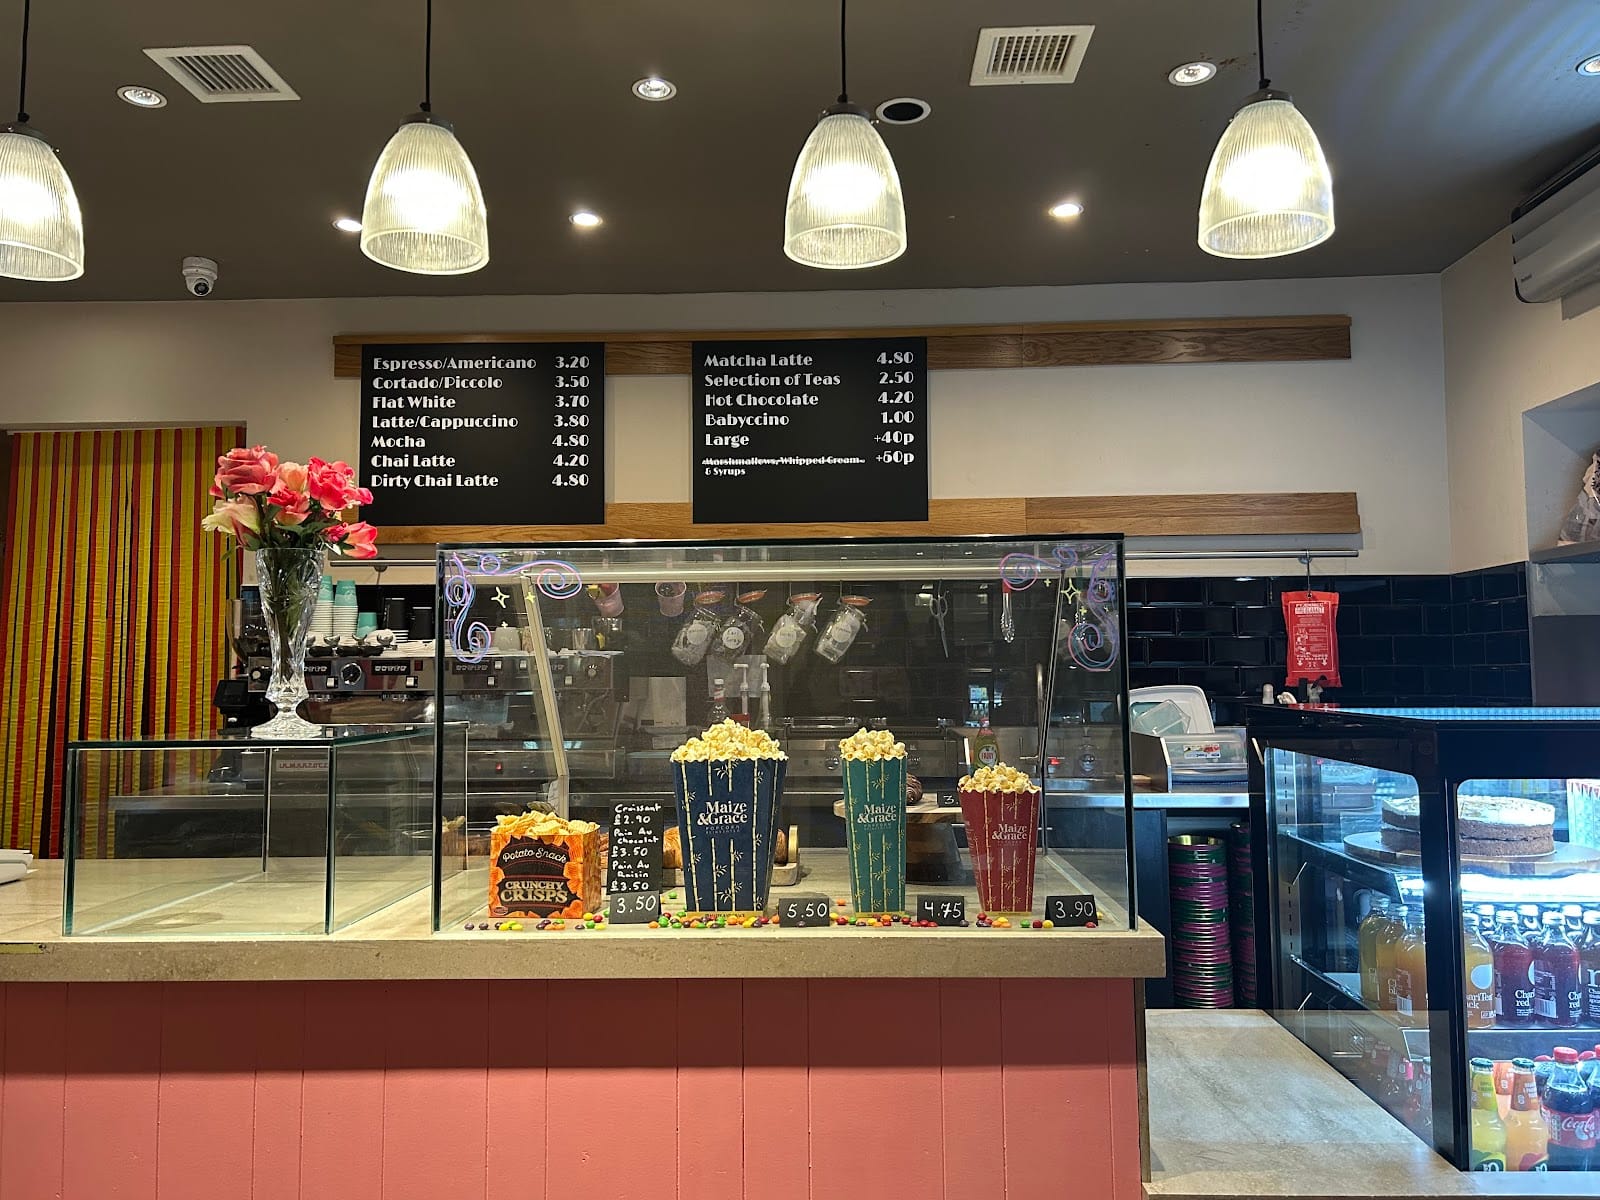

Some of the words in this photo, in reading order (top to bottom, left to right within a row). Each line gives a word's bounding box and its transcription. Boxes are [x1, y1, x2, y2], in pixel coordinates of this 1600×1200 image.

[374, 356, 536, 371] Espresso/Americano
[555, 355, 590, 369] 3.20
[705, 355, 766, 366] Matcha
[771, 354, 812, 366] Latte
[877, 352, 913, 364] 4.80
[373, 376, 502, 389] Cortado/Piccolo
[555, 376, 589, 387] 3.50
[705, 373, 780, 386] Selection
[784, 374, 801, 385] of
[803, 373, 840, 385] Teas
[880, 372, 913, 383] 2.50
[373, 397, 404, 408] Flat
[407, 395, 456, 408] White
[555, 395, 589, 407] 3.70
[706, 395, 733, 406] Hot
[736, 394, 818, 406] Chocolate
[878, 391, 914, 403] 4.20
[373, 415, 518, 429] Latte/Cappuccino
[554, 415, 589, 427] 3.80
[706, 413, 789, 428] Babyccino
[881, 411, 914, 423] 1.00
[371, 436, 425, 447] Mocha
[552, 435, 589, 446] 4.80
[706, 434, 749, 448] Large
[874, 431, 914, 445] +40p
[371, 454, 409, 467] Chai
[413, 455, 455, 467] Latte
[553, 454, 588, 466] 4.20
[876, 451, 914, 465] +50p
[714, 467, 745, 476] Syrups
[372, 474, 411, 489] Dirty
[414, 474, 451, 486] Chai
[456, 475, 498, 486] Latte
[552, 474, 588, 486] 4.80
[944, 795, 959, 805] 3.
[614, 803, 662, 813] Croissant
[705, 800, 748, 815] Maize
[863, 803, 897, 815] Maize
[613, 813, 651, 826] £2.90
[696, 812, 748, 826] &Grace
[857, 812, 897, 824] &Grace
[613, 828, 633, 837] Pain
[638, 827, 653, 835] Au
[991, 830, 1028, 840] &Grace
[998, 823, 1028, 834] Maize
[502, 848, 535, 862] Potato
[535, 847, 567, 863] Snack
[611, 845, 648, 858] £3.50
[612, 860, 633, 870] Pain
[636, 859, 650, 869] Au
[617, 870, 649, 878] Raisin
[505, 880, 564, 890] CRUNCHY
[610, 879, 649, 892] £3.50
[500, 889, 568, 904] CRISPS
[616, 895, 657, 914] 3.50
[787, 903, 827, 918] 5.50
[924, 902, 962, 919] 4.75
[1055, 900, 1094, 919] 3.90
